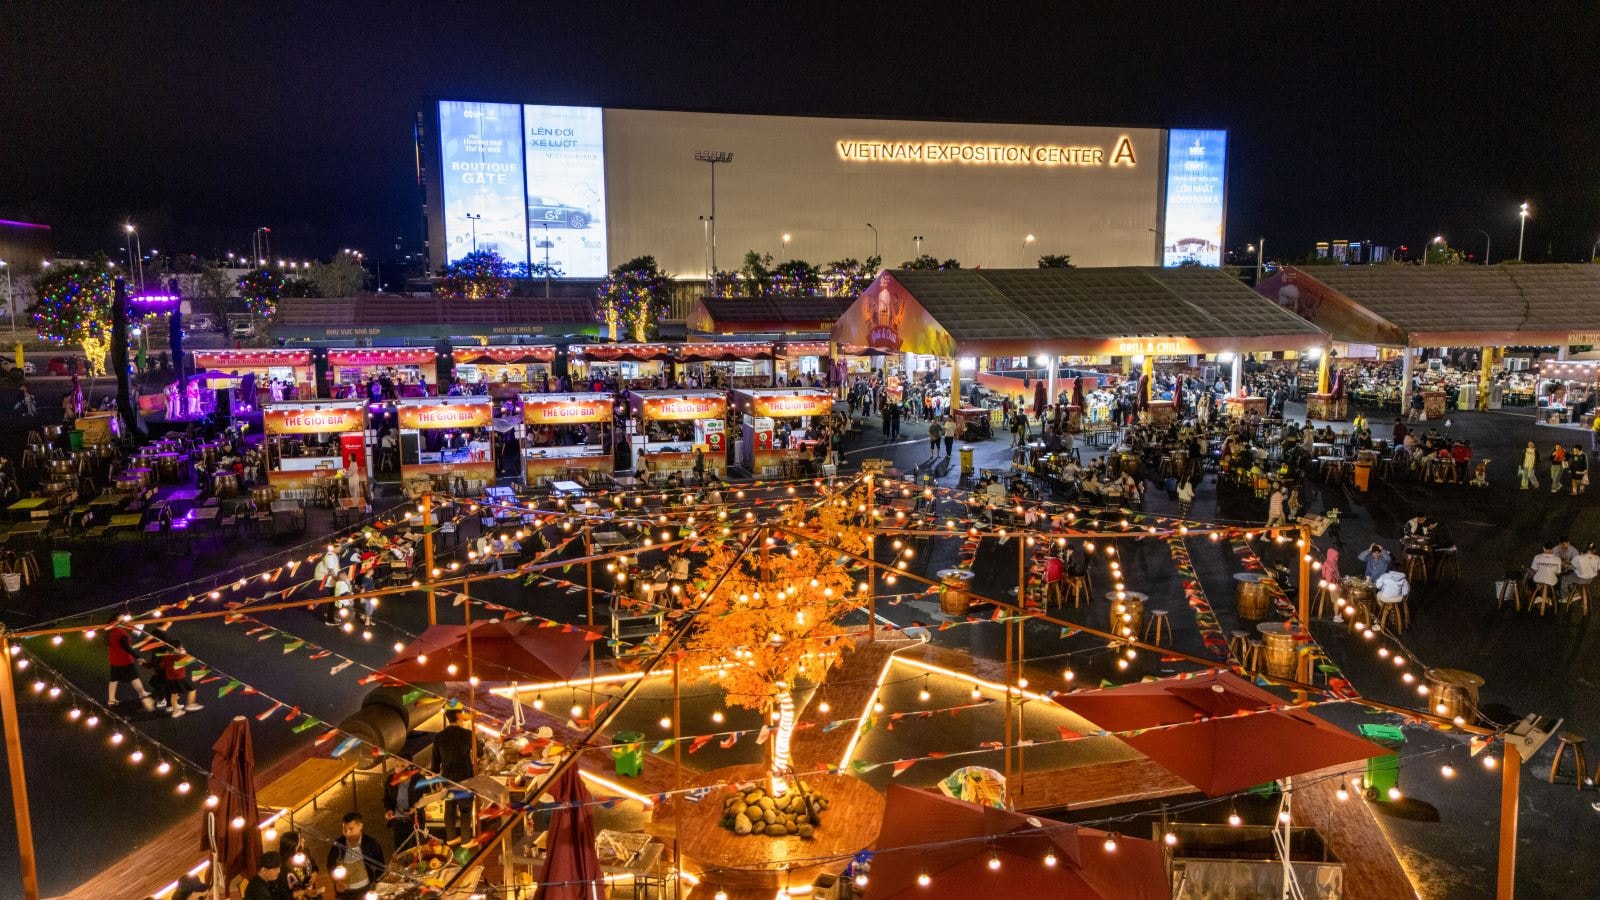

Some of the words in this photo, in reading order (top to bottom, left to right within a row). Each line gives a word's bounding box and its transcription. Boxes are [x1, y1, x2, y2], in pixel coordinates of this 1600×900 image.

[531, 139, 548, 147] XE
[840, 142, 922, 160] VIETNAM
[927, 145, 1031, 162] EXPOSITION
[1036, 147, 1104, 164] CENTER
[1113, 137, 1137, 165] A
[451, 161, 517, 172] BOUTIQUE
[462, 172, 507, 185] GATE
[1119, 342, 1144, 353] GRILL
[1156, 342, 1181, 353] CHILL
[696, 404, 710, 413] BIA
[803, 401, 816, 409] BIA
[458, 412, 474, 421] BIA
[580, 408, 595, 416] BIA
[327, 416, 343, 425] BIA
